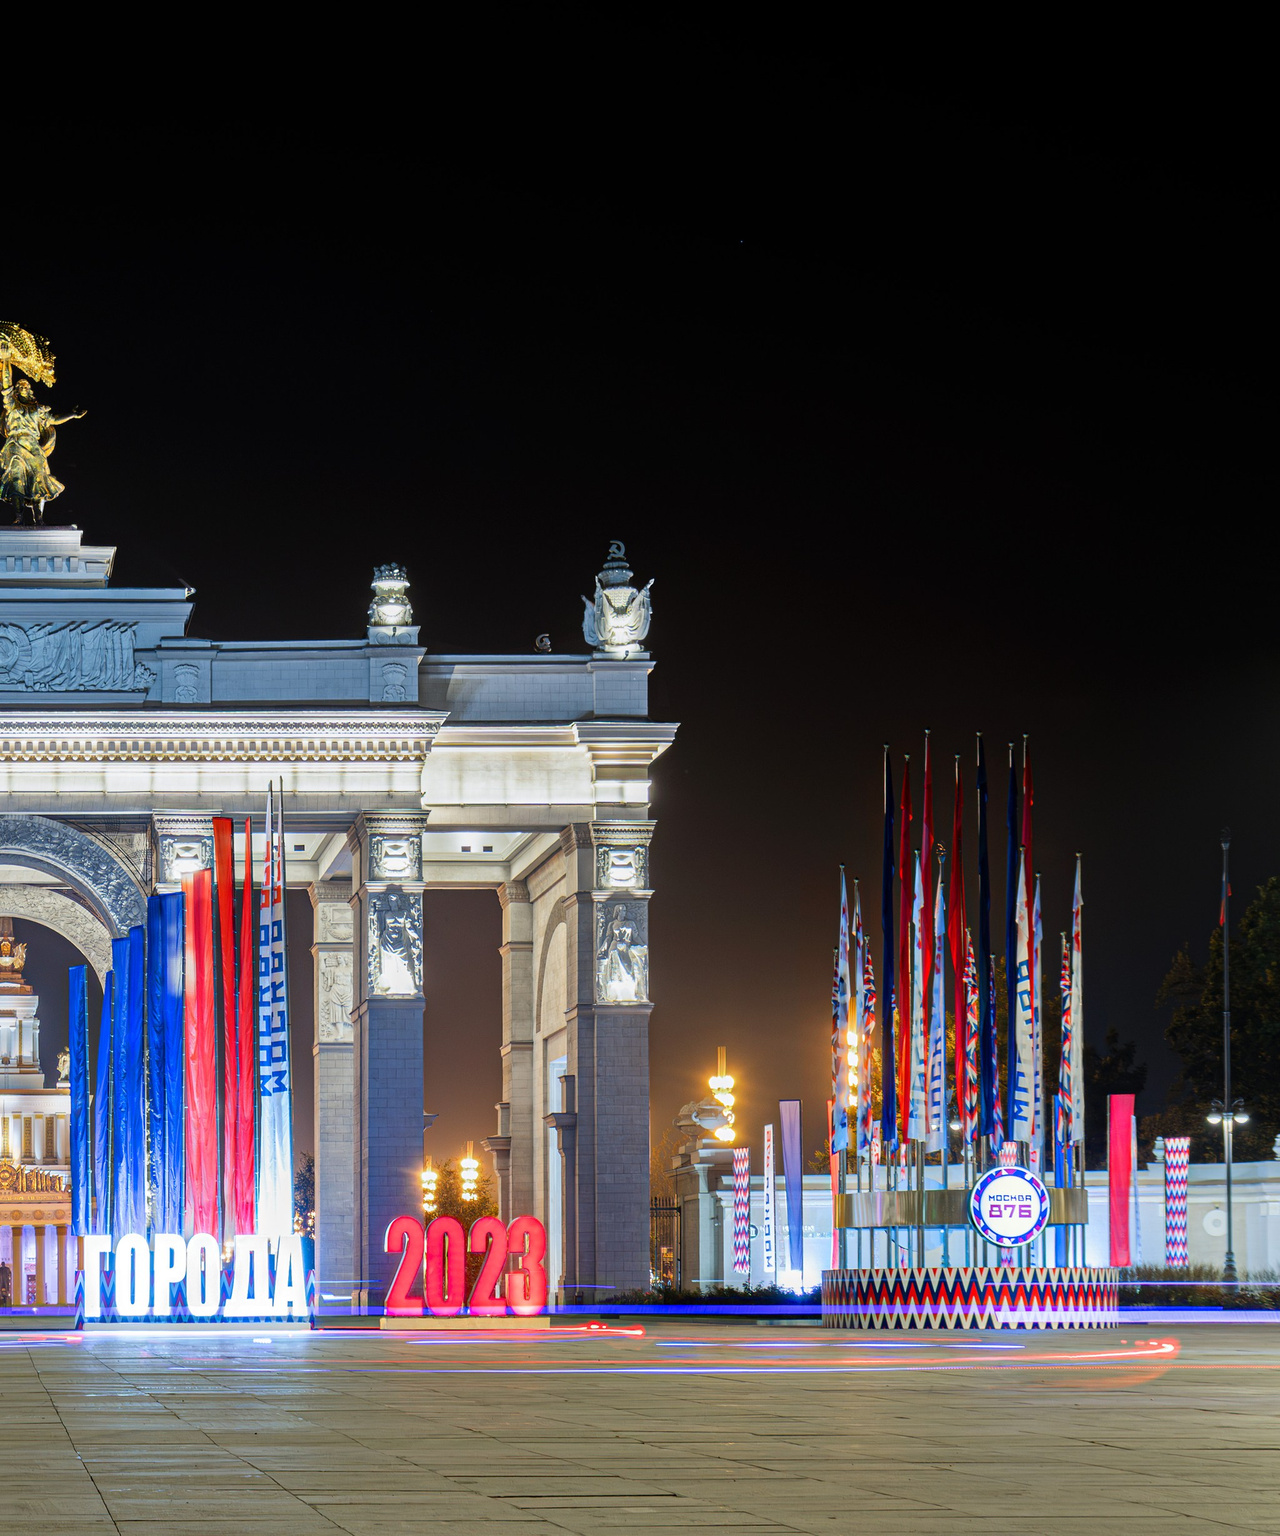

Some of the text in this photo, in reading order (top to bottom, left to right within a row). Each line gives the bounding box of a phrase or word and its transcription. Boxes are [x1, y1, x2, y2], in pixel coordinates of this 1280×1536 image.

[988, 1204, 1032, 1219] 876
[83, 1233, 309, 1318] ГОРОДА
[384, 1215, 548, 1317] 2023
